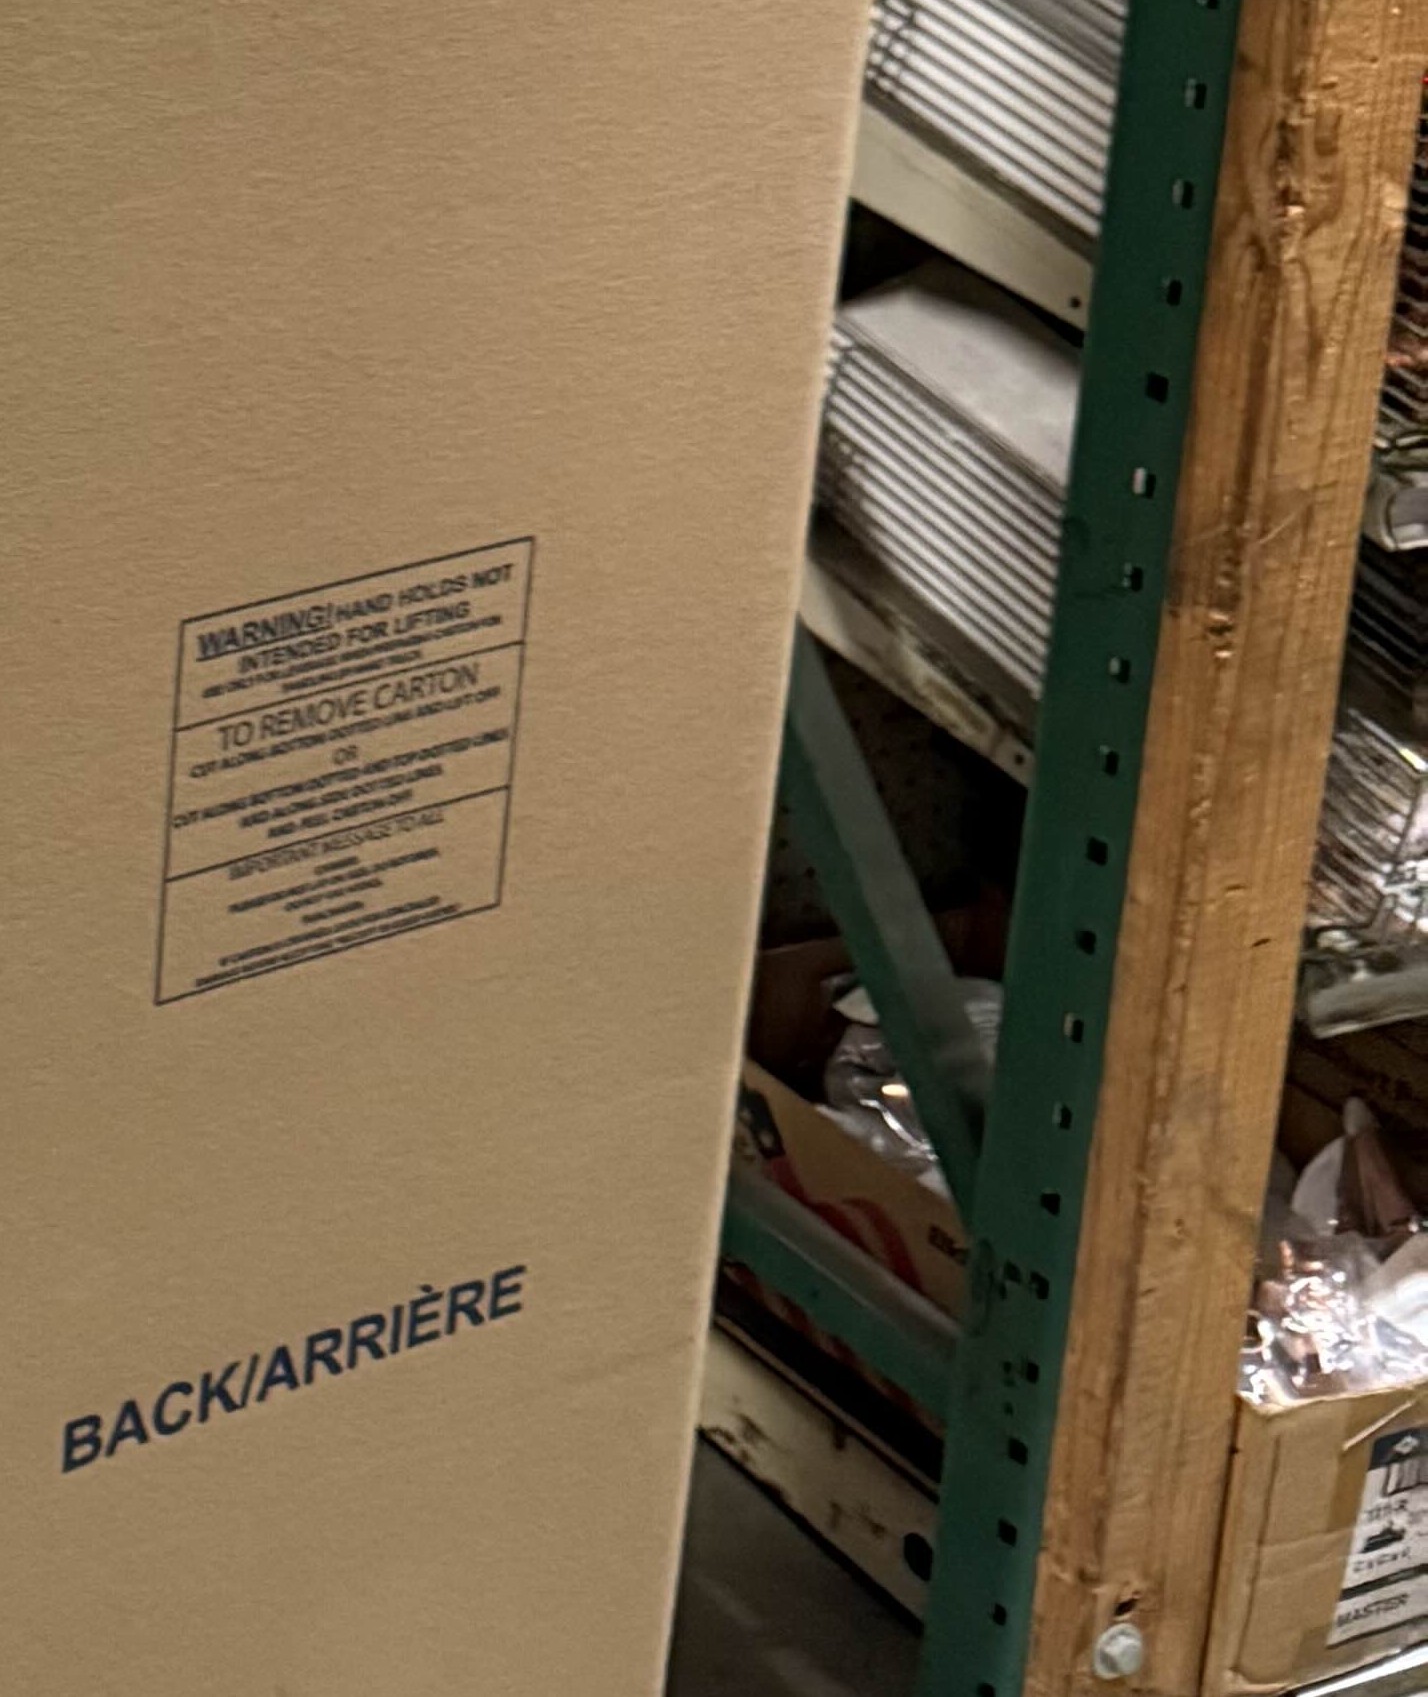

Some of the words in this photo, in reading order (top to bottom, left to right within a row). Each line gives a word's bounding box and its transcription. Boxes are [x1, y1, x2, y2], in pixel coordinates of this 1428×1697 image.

[197, 602, 333, 660] WARNING!
[335, 593, 391, 622] HAND
[398, 574, 469, 607] HOLDS
[471, 563, 514, 589] NOT
[239, 632, 342, 674] INTENDED
[346, 621, 389, 645] FOR
[393, 600, 471, 635] LIFTING
[217, 720, 255, 751] TO
[259, 689, 368, 740] REMOVE
[373, 663, 479, 710] CARTON
[61, 1265, 528, 1474] BACK/ARRIÈRE
